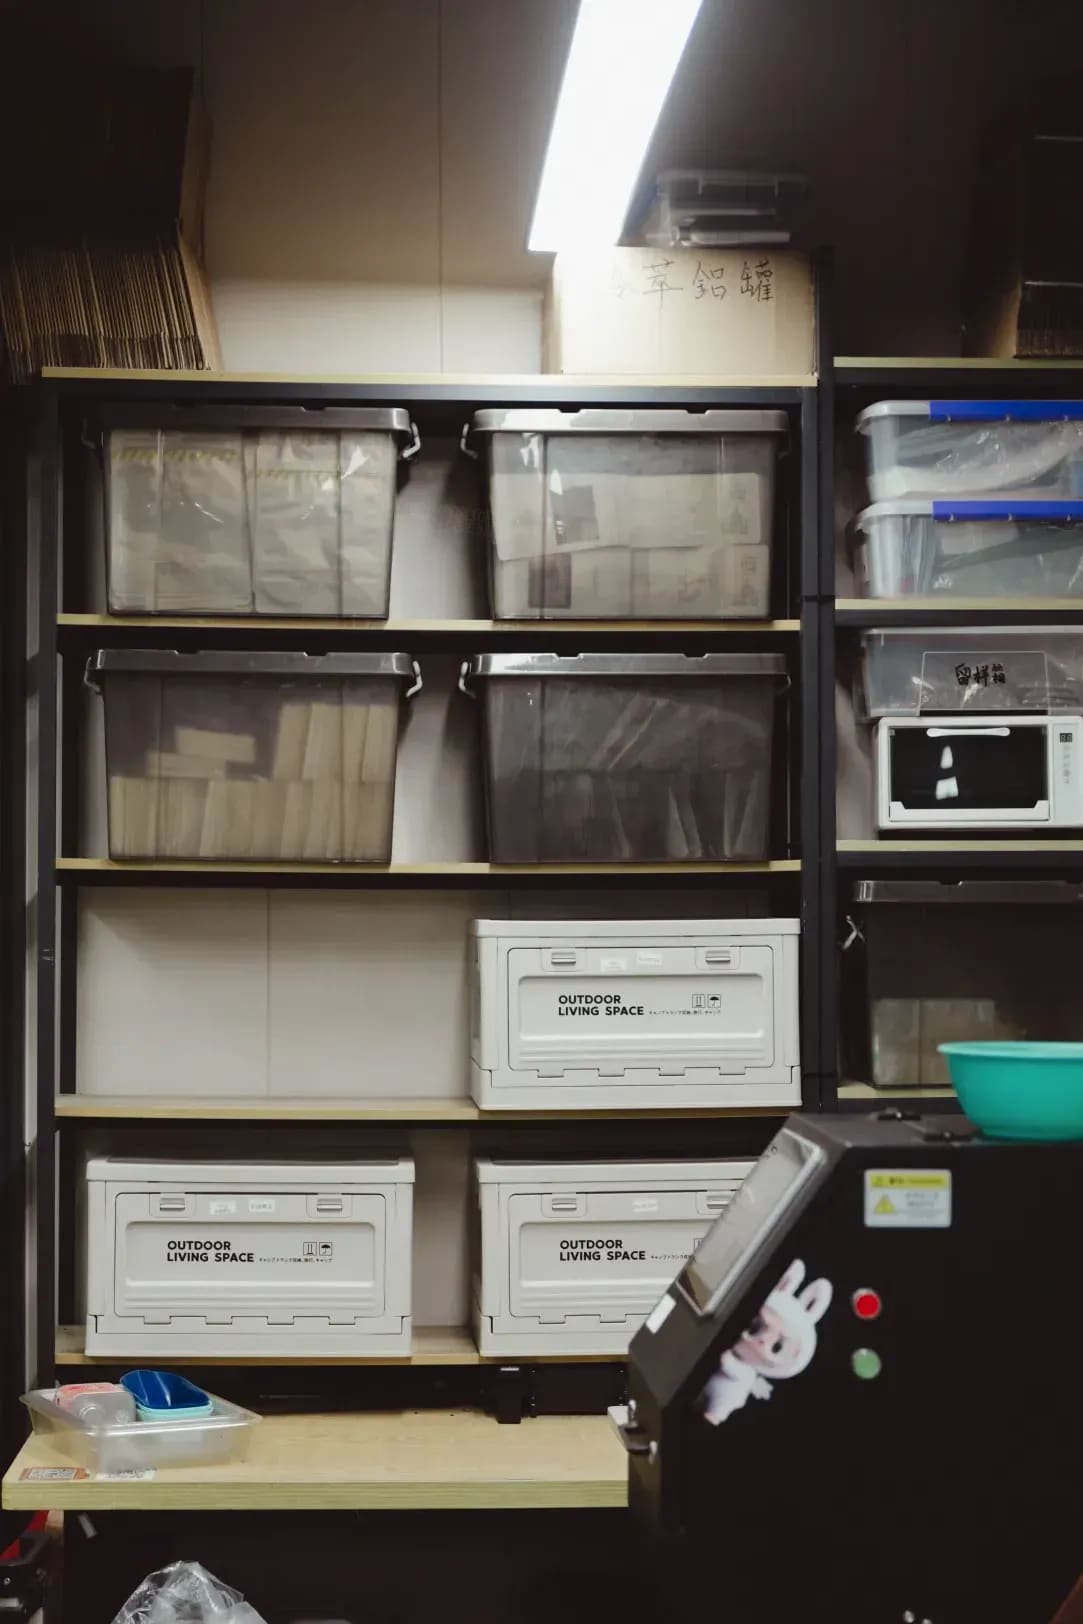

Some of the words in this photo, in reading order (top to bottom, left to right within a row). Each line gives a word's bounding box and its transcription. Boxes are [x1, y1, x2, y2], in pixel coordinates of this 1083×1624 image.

[558, 994, 621, 1005] OUTDOOR
[558, 1006, 600, 1016] LIVING
[605, 1006, 644, 1016] SPACE
[167, 1240, 232, 1251] OUTDOOR
[559, 1239, 623, 1250] OUTDOOR
[166, 1252, 209, 1263] LIVING
[214, 1252, 255, 1263] SPACE
[559, 1250, 601, 1262] LIVING
[606, 1250, 646, 1262] SPACE
